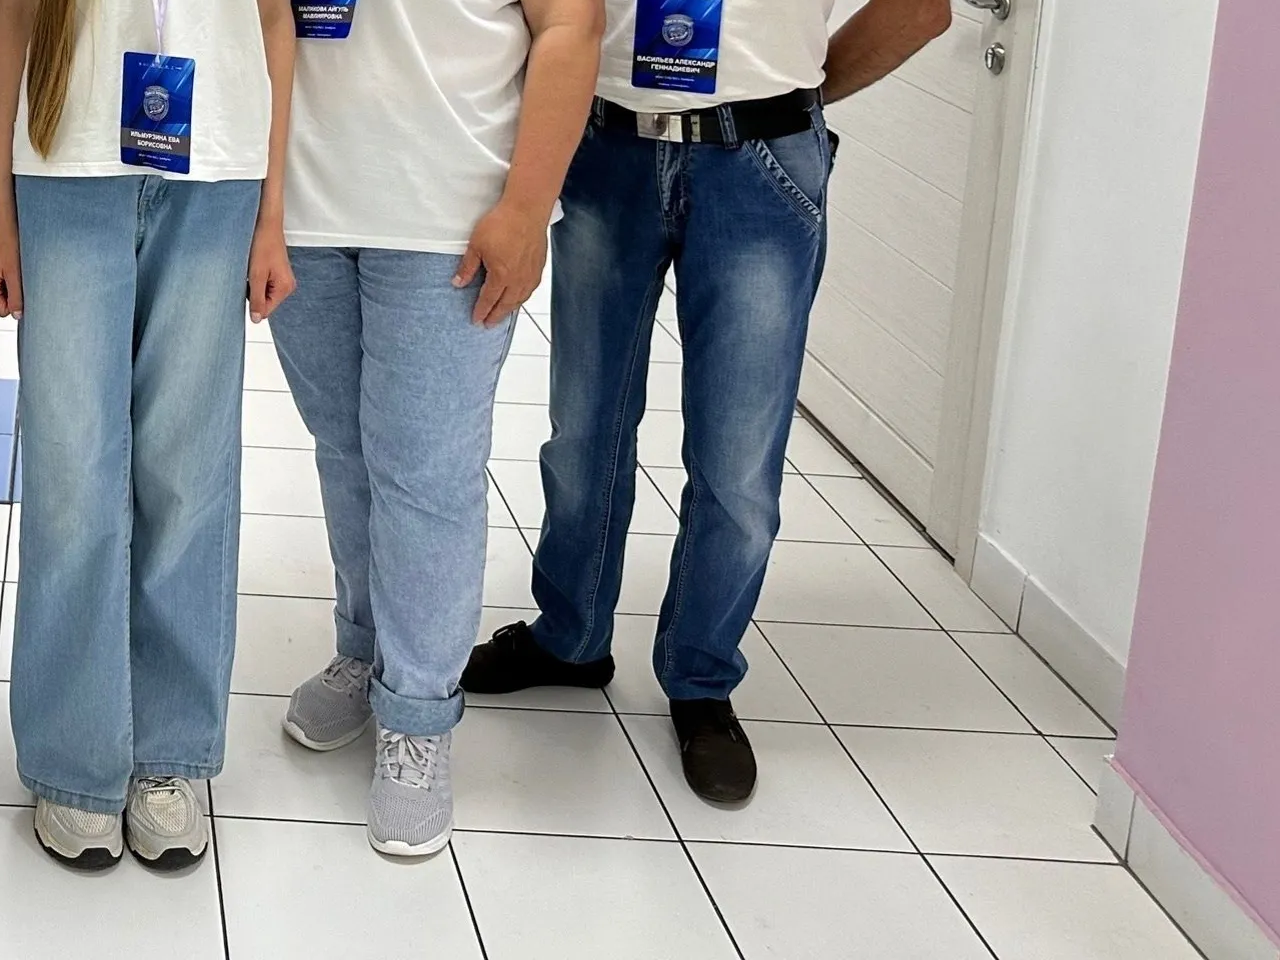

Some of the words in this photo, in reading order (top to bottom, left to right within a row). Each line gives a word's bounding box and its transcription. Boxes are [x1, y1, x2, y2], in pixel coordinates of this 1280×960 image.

[636, 55, 674, 64] ВАСИЛЬЕВ
[674, 58, 716, 68] АЛЕКСАНДР
[650, 63, 701, 74] ГЕННАДИЕВИЧ
[137, 140, 173, 150] БОРИСОВНА
[168, 136, 180, 144] ЕВА
